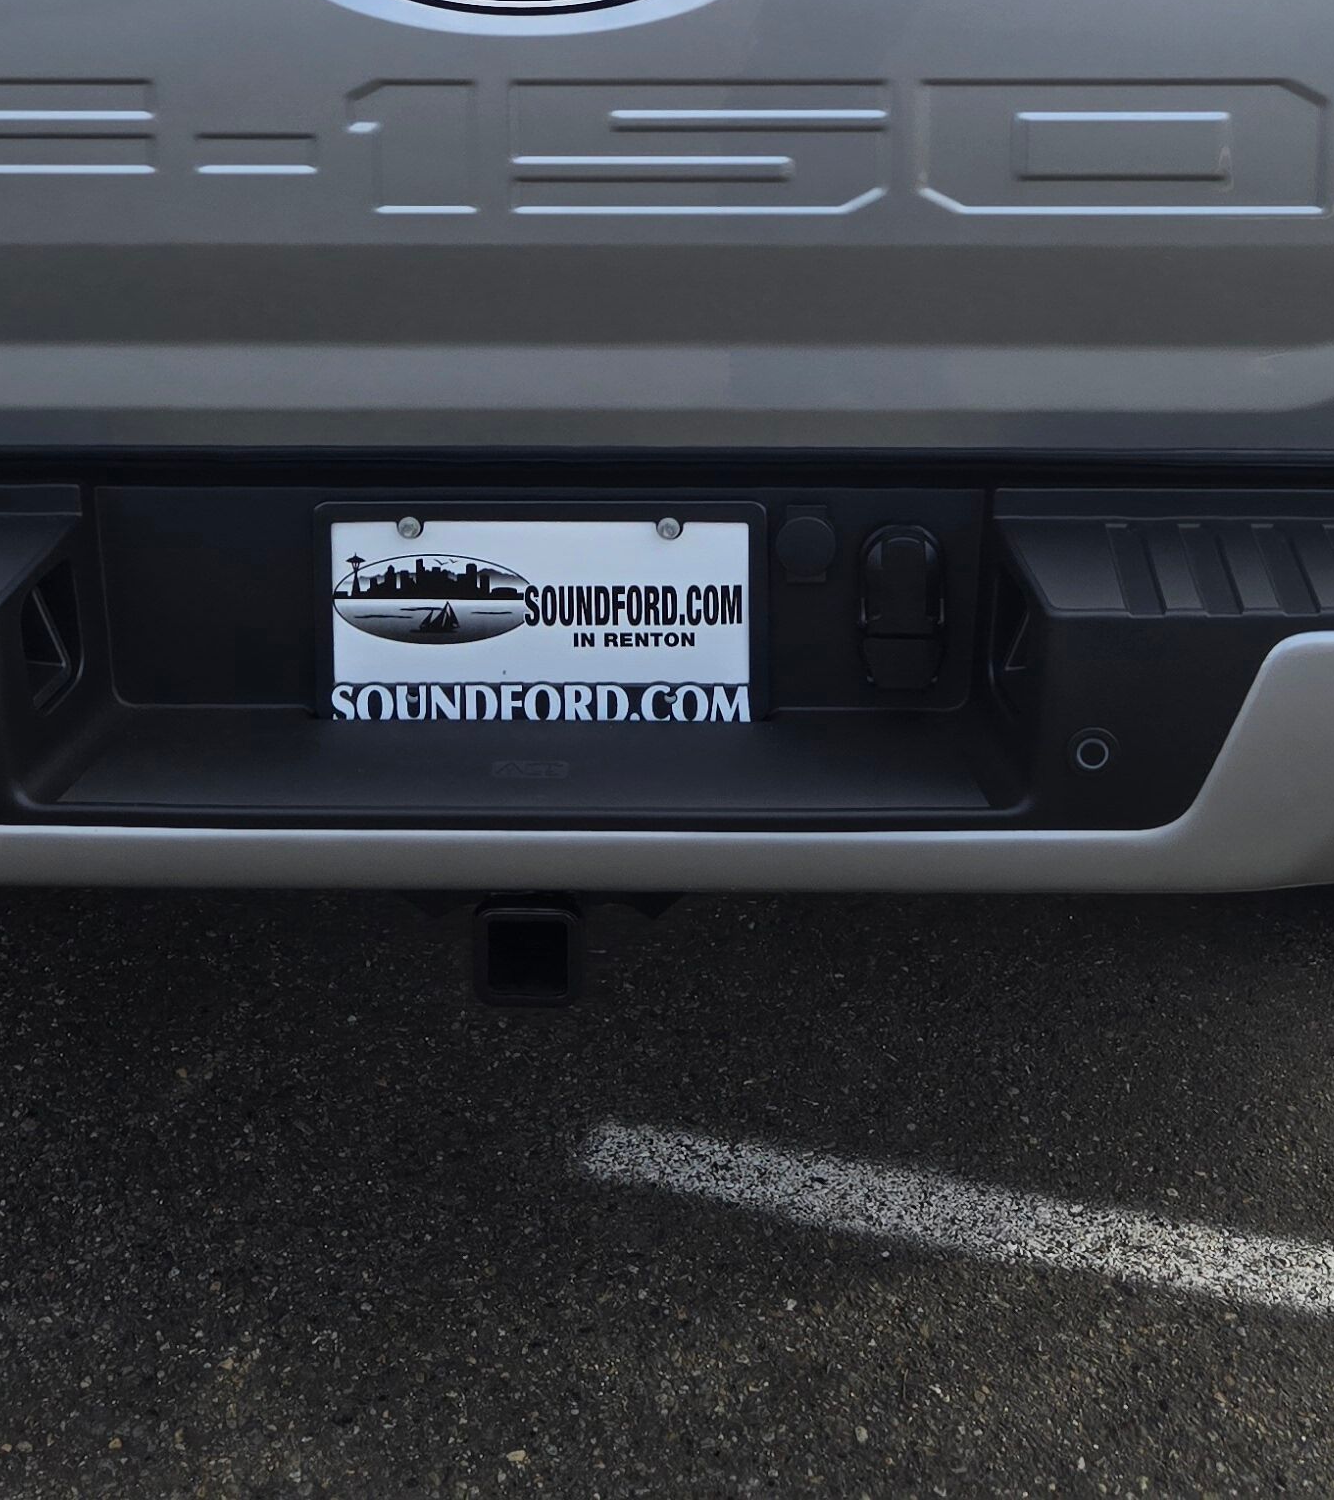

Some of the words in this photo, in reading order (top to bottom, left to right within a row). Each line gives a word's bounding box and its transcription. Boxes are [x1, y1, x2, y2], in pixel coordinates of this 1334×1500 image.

[524, 584, 743, 626] SOUNDFORD.COM
[572, 633, 596, 648] IN
[604, 632, 696, 648] RENTON
[331, 684, 751, 722] SOUNDFORD.COM
